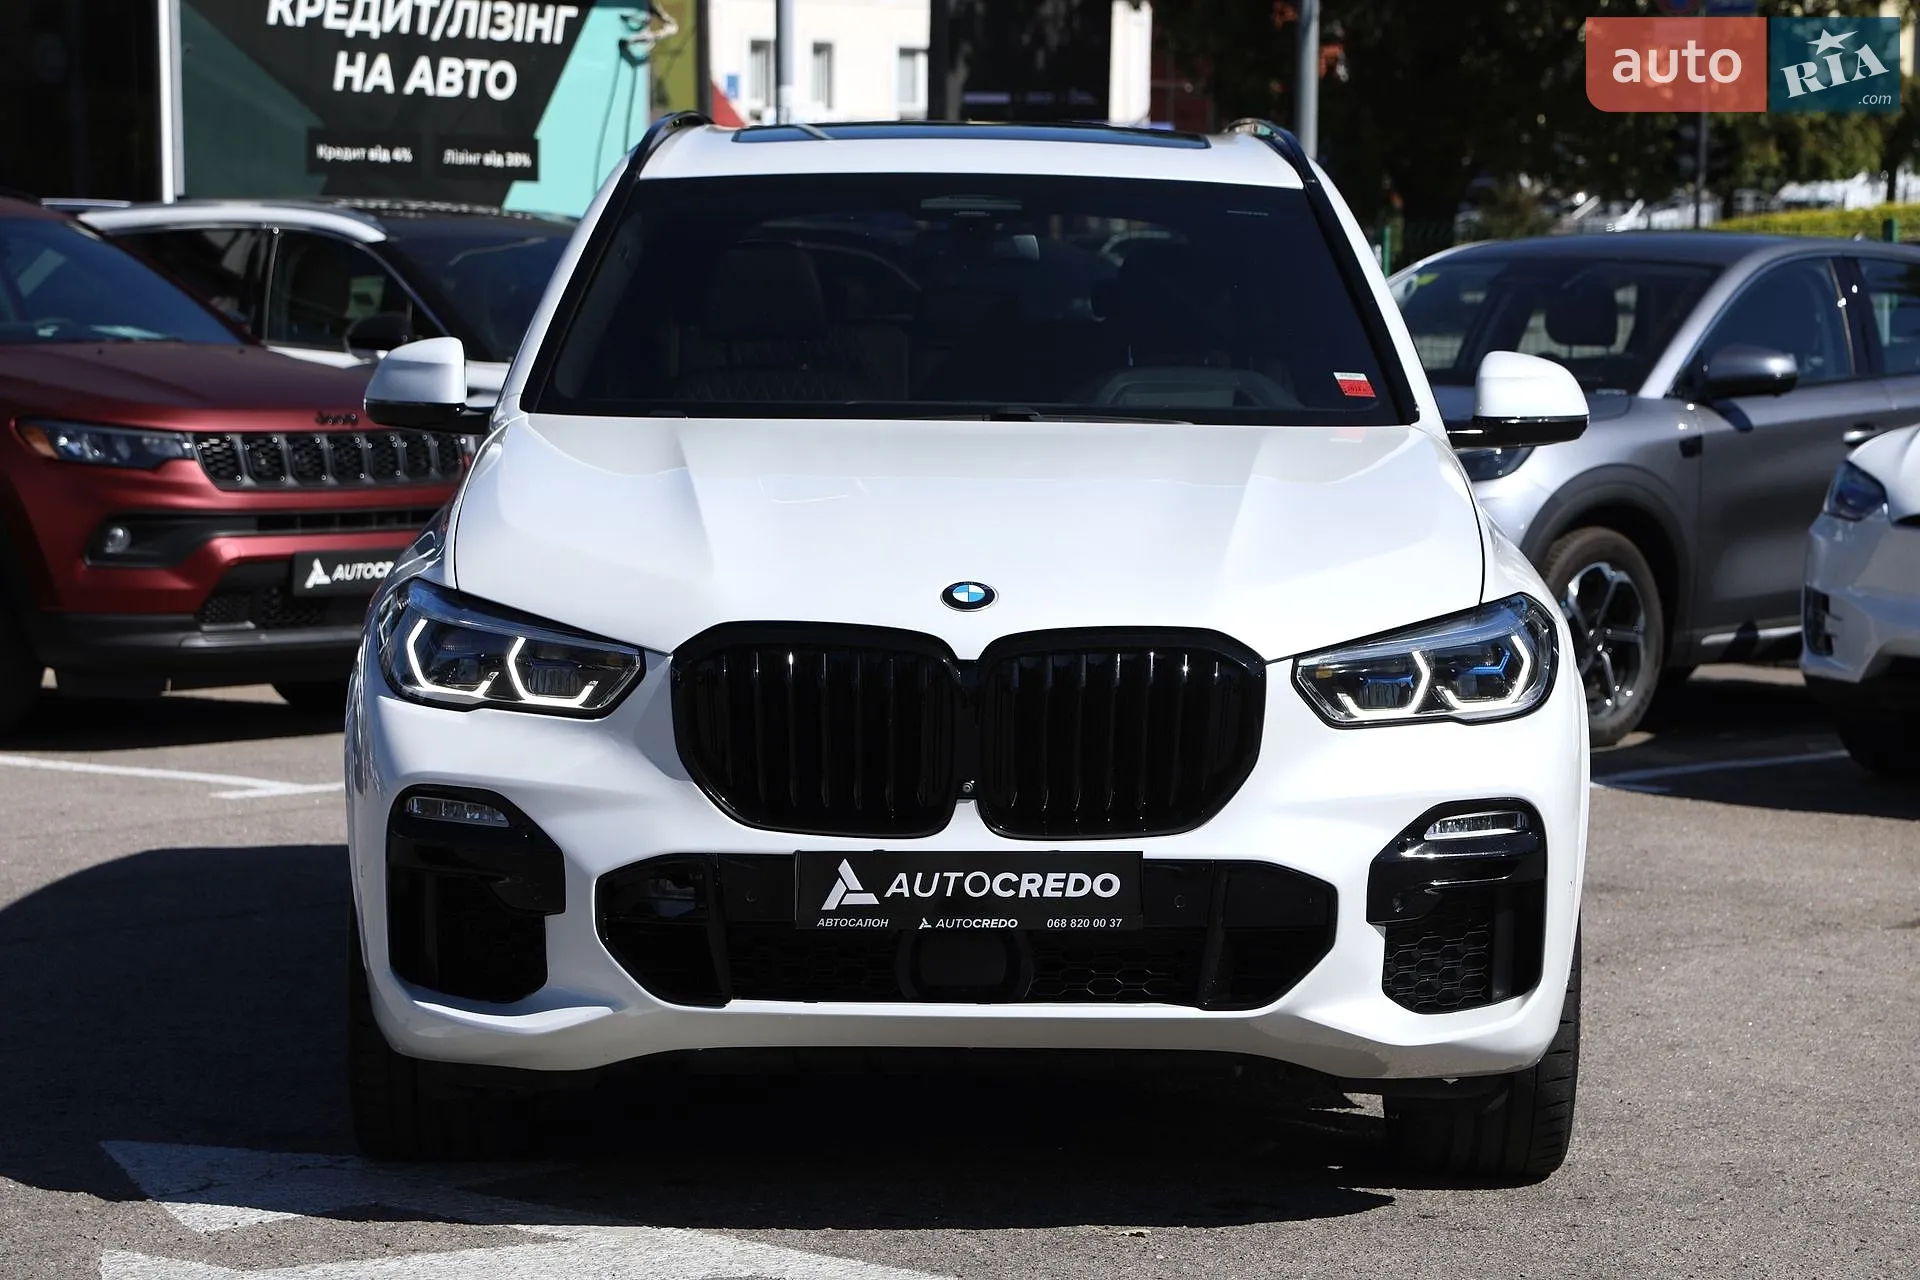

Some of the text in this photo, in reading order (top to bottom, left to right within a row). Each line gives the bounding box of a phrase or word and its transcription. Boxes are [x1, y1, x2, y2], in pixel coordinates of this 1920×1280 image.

[266, 0, 579, 44] КРЕДИТ/ЛІЗІНГ
[332, 50, 517, 101] НА АВТО
[316, 144, 366, 162] Кредит
[367, 145, 390, 163] від
[442, 148, 481, 166] Лізінг
[482, 151, 504, 168] від
[884, 871, 1121, 898] AUTOCREDO
[816, 917, 889, 928] АВТОСАЛОН
[935, 918, 1018, 930] AUTOCREDO
[1046, 917, 1123, 929] 068 820 00 37
